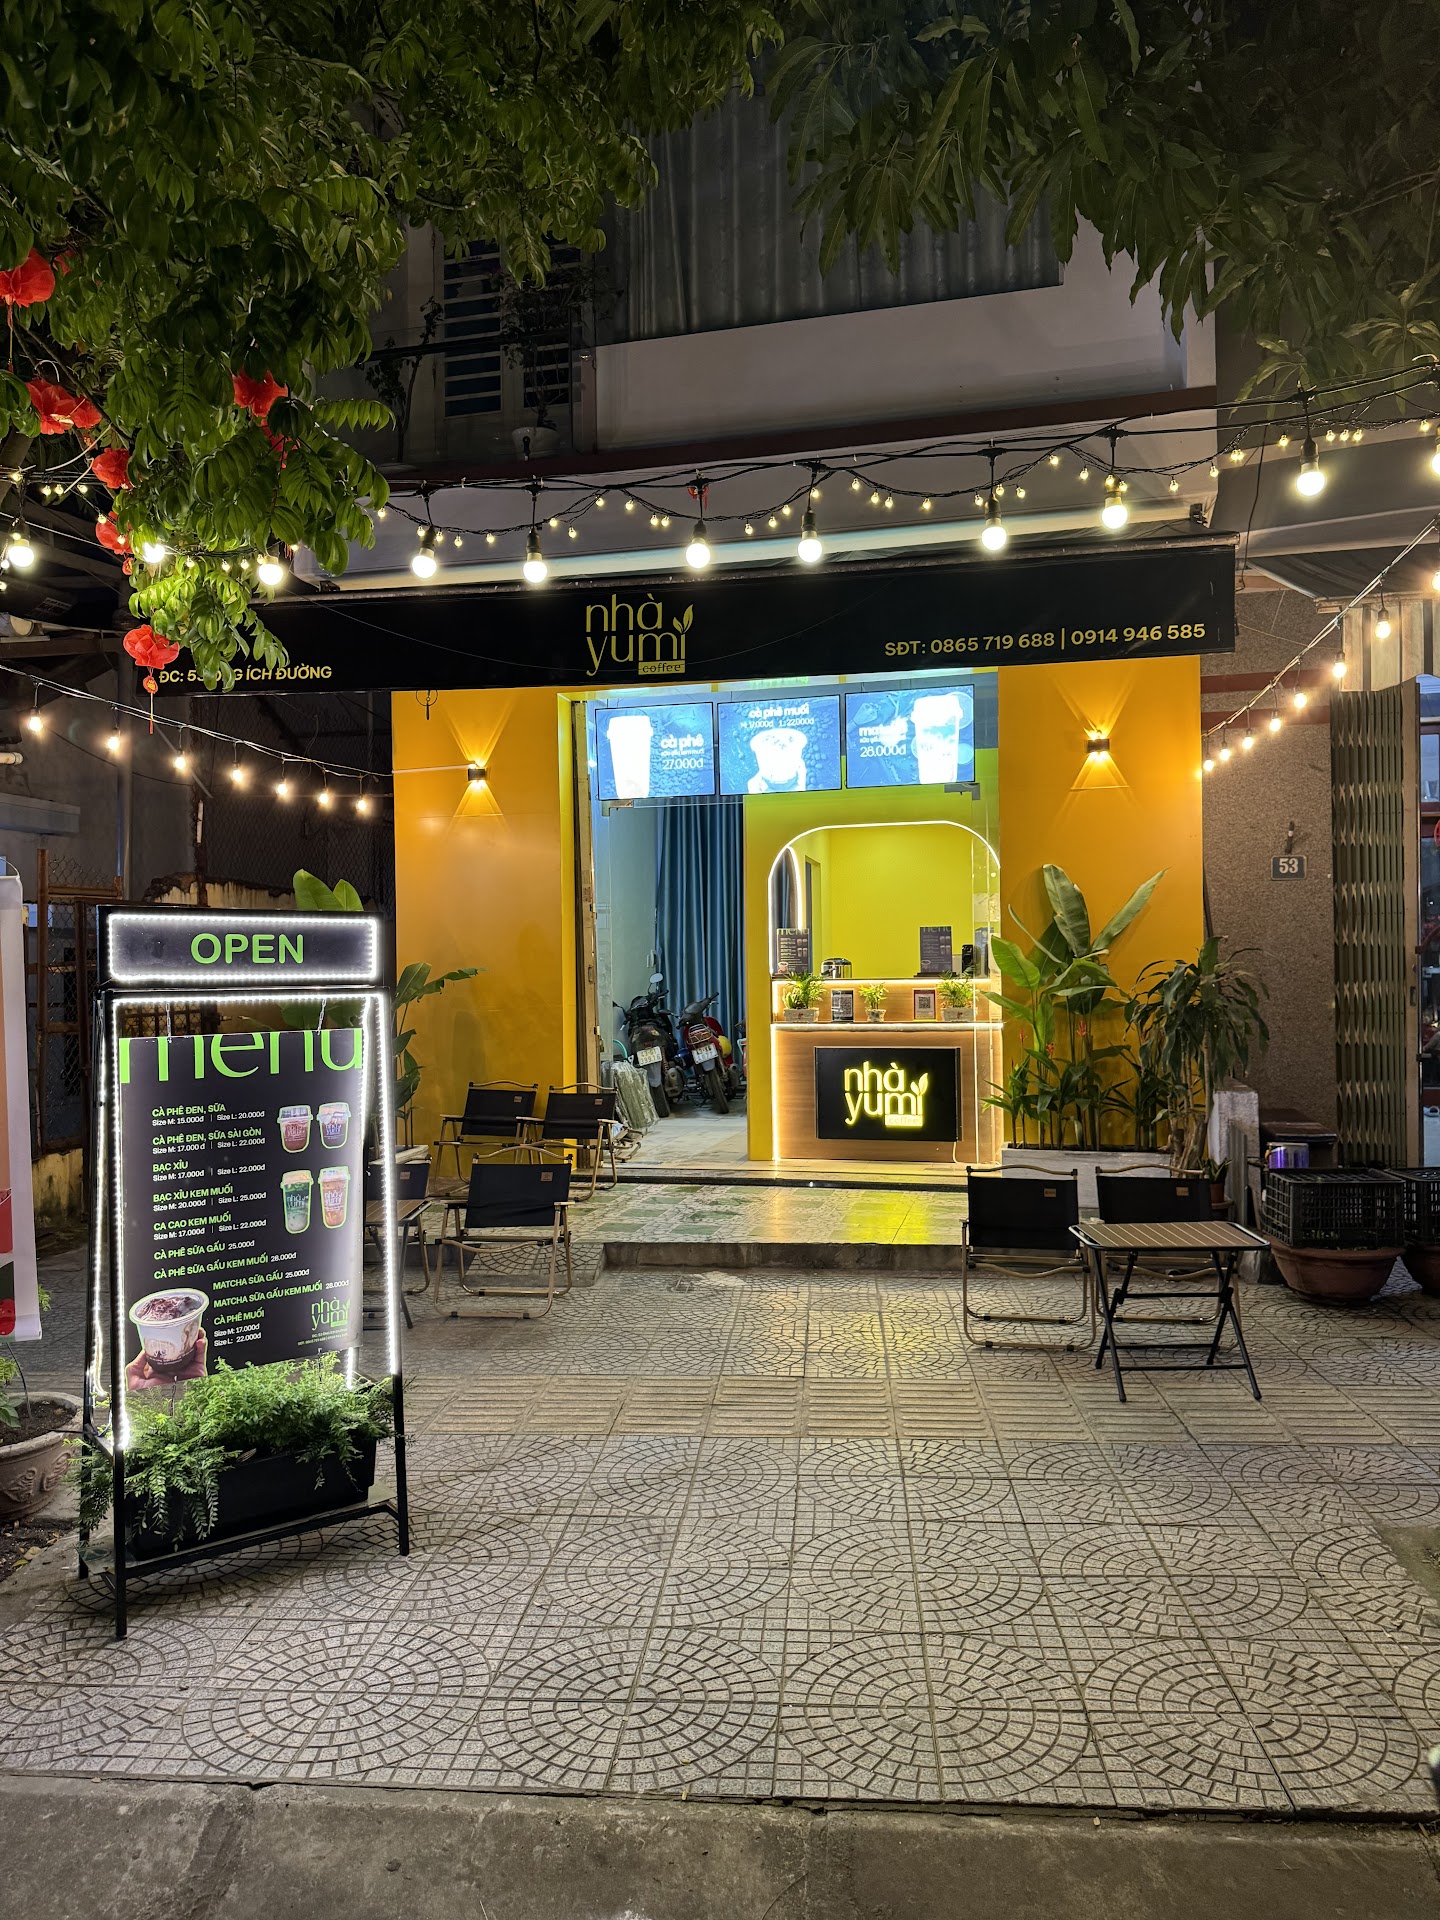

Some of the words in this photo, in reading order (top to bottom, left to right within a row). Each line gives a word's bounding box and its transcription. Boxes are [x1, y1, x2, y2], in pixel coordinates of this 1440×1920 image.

[586, 593, 662, 632] nhà
[884, 641, 926, 656] SĐT:
[931, 637, 979, 654] 0865
[983, 635, 1014, 650] 719
[1021, 632, 1055, 648] 688
[1071, 628, 1118, 646] 0914
[1123, 626, 1162, 641] 946
[1167, 624, 1206, 639] 585
[586, 633, 685, 676] yumi
[159, 671, 184, 683] ĐC:
[246, 665, 272, 680] ÍCH
[276, 663, 332, 680] ĐƯỜNG
[643, 663, 680, 673] coffee
[1279, 858, 1298, 873] 53
[191, 933, 303, 964] OPEN
[119, 1028, 362, 1083] menu
[844, 1061, 904, 1091] nhà
[152, 1107, 165, 1117] CÀ
[167, 1106, 184, 1115] PHÊ
[186, 1106, 206, 1114] ĐEN,
[208, 1103, 226, 1112] SỮA
[845, 1093, 922, 1124] yumi
[153, 1135, 165, 1145] CÀ
[167, 1134, 184, 1143] PHÊ
[186, 1134, 206, 1142] ĐEN,
[208, 1130, 226, 1140] SỮA
[228, 1128, 241, 1138] SÀI
[243, 1127, 261, 1137] GÒN
[153, 1163, 171, 1173] BẠC
[153, 1193, 172, 1203] BẠC
[190, 1189, 209, 1198] KEM
[210, 1183, 233, 1195] MUỐI
[154, 1222, 166, 1231] CA
[168, 1220, 186, 1229] CAO
[188, 1217, 207, 1226] KEM
[209, 1211, 231, 1223] MUỐI
[154, 1249, 166, 1260] CÀ
[168, 1247, 185, 1258] PHÊ
[187, 1246, 205, 1255] SỮA
[207, 1240, 225, 1252] GẤU
[154, 1268, 166, 1279] CÀ
[169, 1266, 185, 1277] PHÊ
[187, 1264, 205, 1274] SỮA
[207, 1259, 225, 1272] GẤU
[227, 1259, 244, 1268] KEM
[246, 1252, 268, 1265] MUỐI
[213, 1279, 247, 1290] MATCHA
[248, 1274, 265, 1284] SỮA
[266, 1268, 283, 1281] GẤU
[214, 1296, 248, 1308] MATCHA
[249, 1291, 265, 1302] SỮA
[267, 1287, 283, 1299] GẤU
[285, 1286, 301, 1296] KEM
[302, 1280, 322, 1294] MUỐI
[312, 1297, 339, 1314] nhà
[214, 1314, 226, 1325] CÀ
[227, 1312, 242, 1323] PHÊ
[244, 1307, 264, 1320] MUỐI
[312, 1310, 348, 1330] yumi
